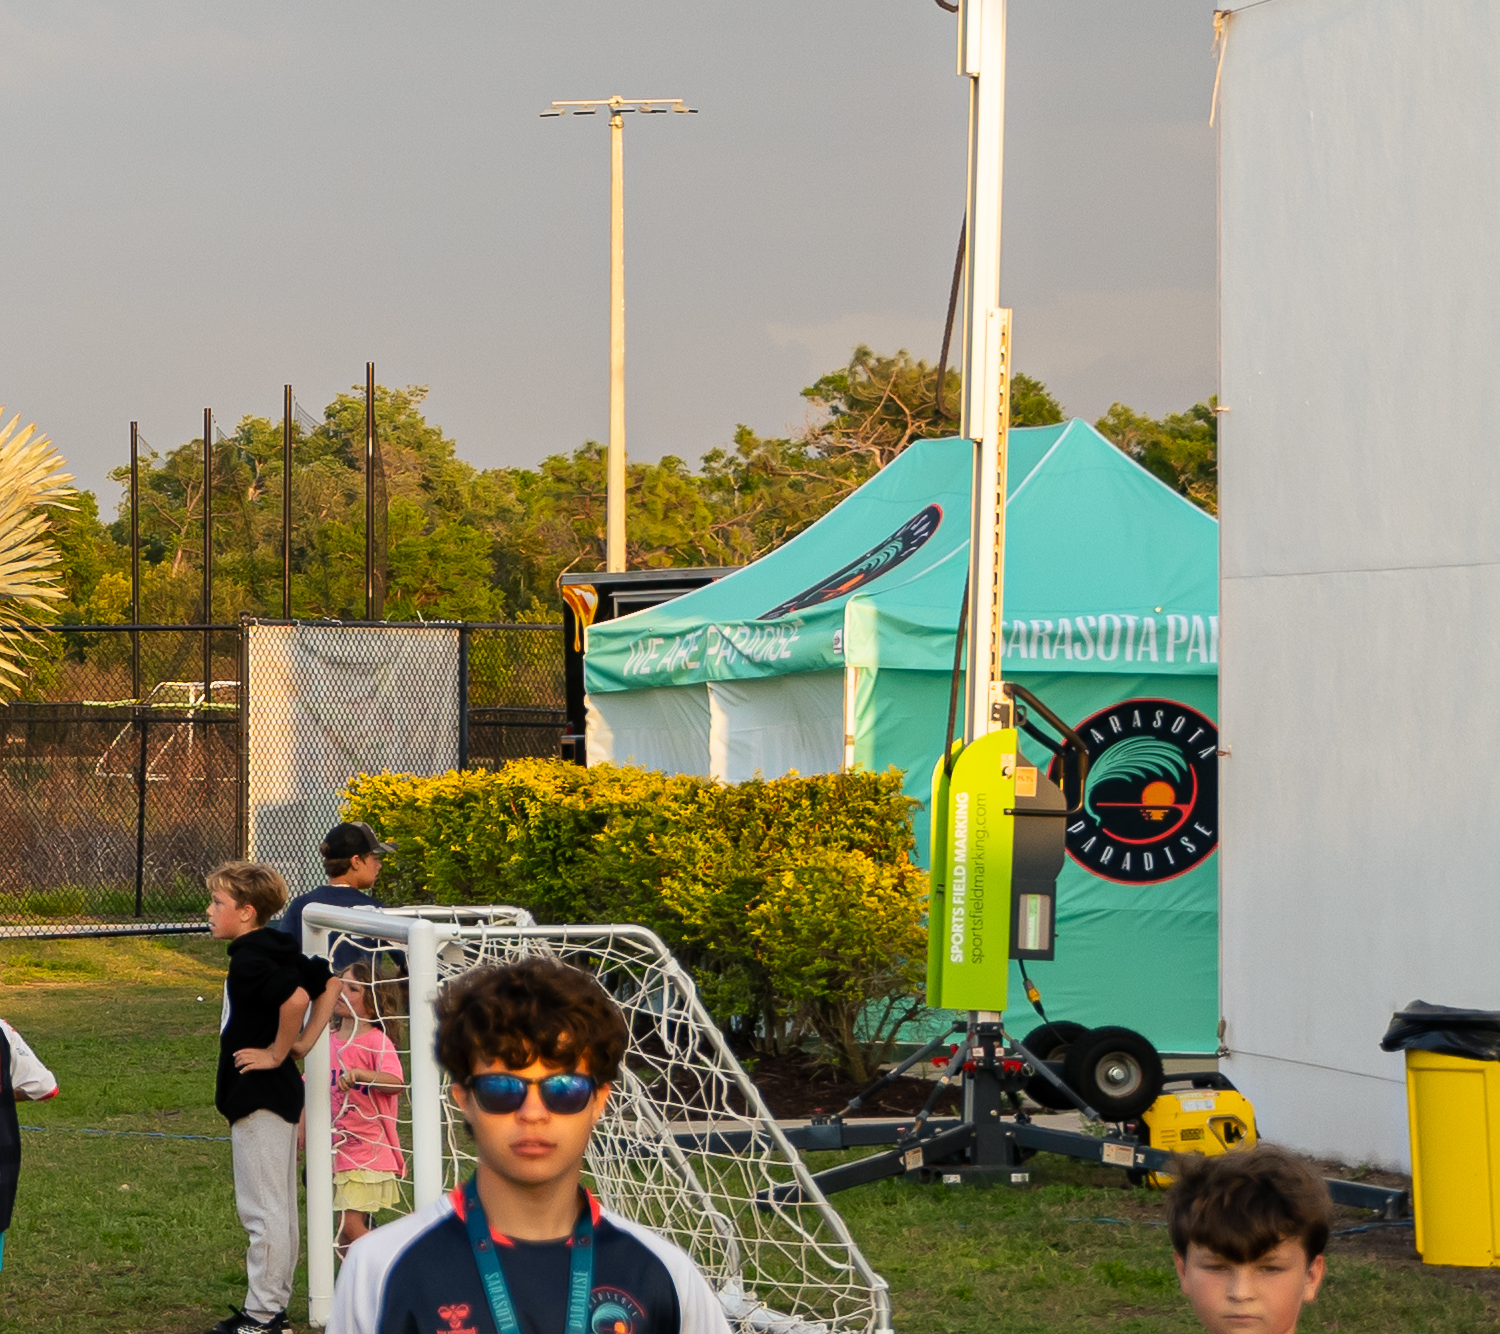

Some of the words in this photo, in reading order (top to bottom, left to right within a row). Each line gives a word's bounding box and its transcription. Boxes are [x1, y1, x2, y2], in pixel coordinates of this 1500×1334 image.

[623, 637, 664, 677] WE
[656, 629, 703, 672] ARE
[703, 618, 804, 667] PARADISE
[1001, 613, 1159, 662] ARASOTA
[1090, 709, 1217, 760] ARASOTA
[953, 792, 969, 863] MARKING
[1067, 819, 1213, 872] PARADISE
[952, 865, 966, 905] FIELD
[969, 792, 989, 964] sportsfieldmarking.com
[950, 907, 965, 963] SPORTS
[484, 1271, 515, 1331] SARASOTA
[569, 1270, 589, 1328] PARADISE
